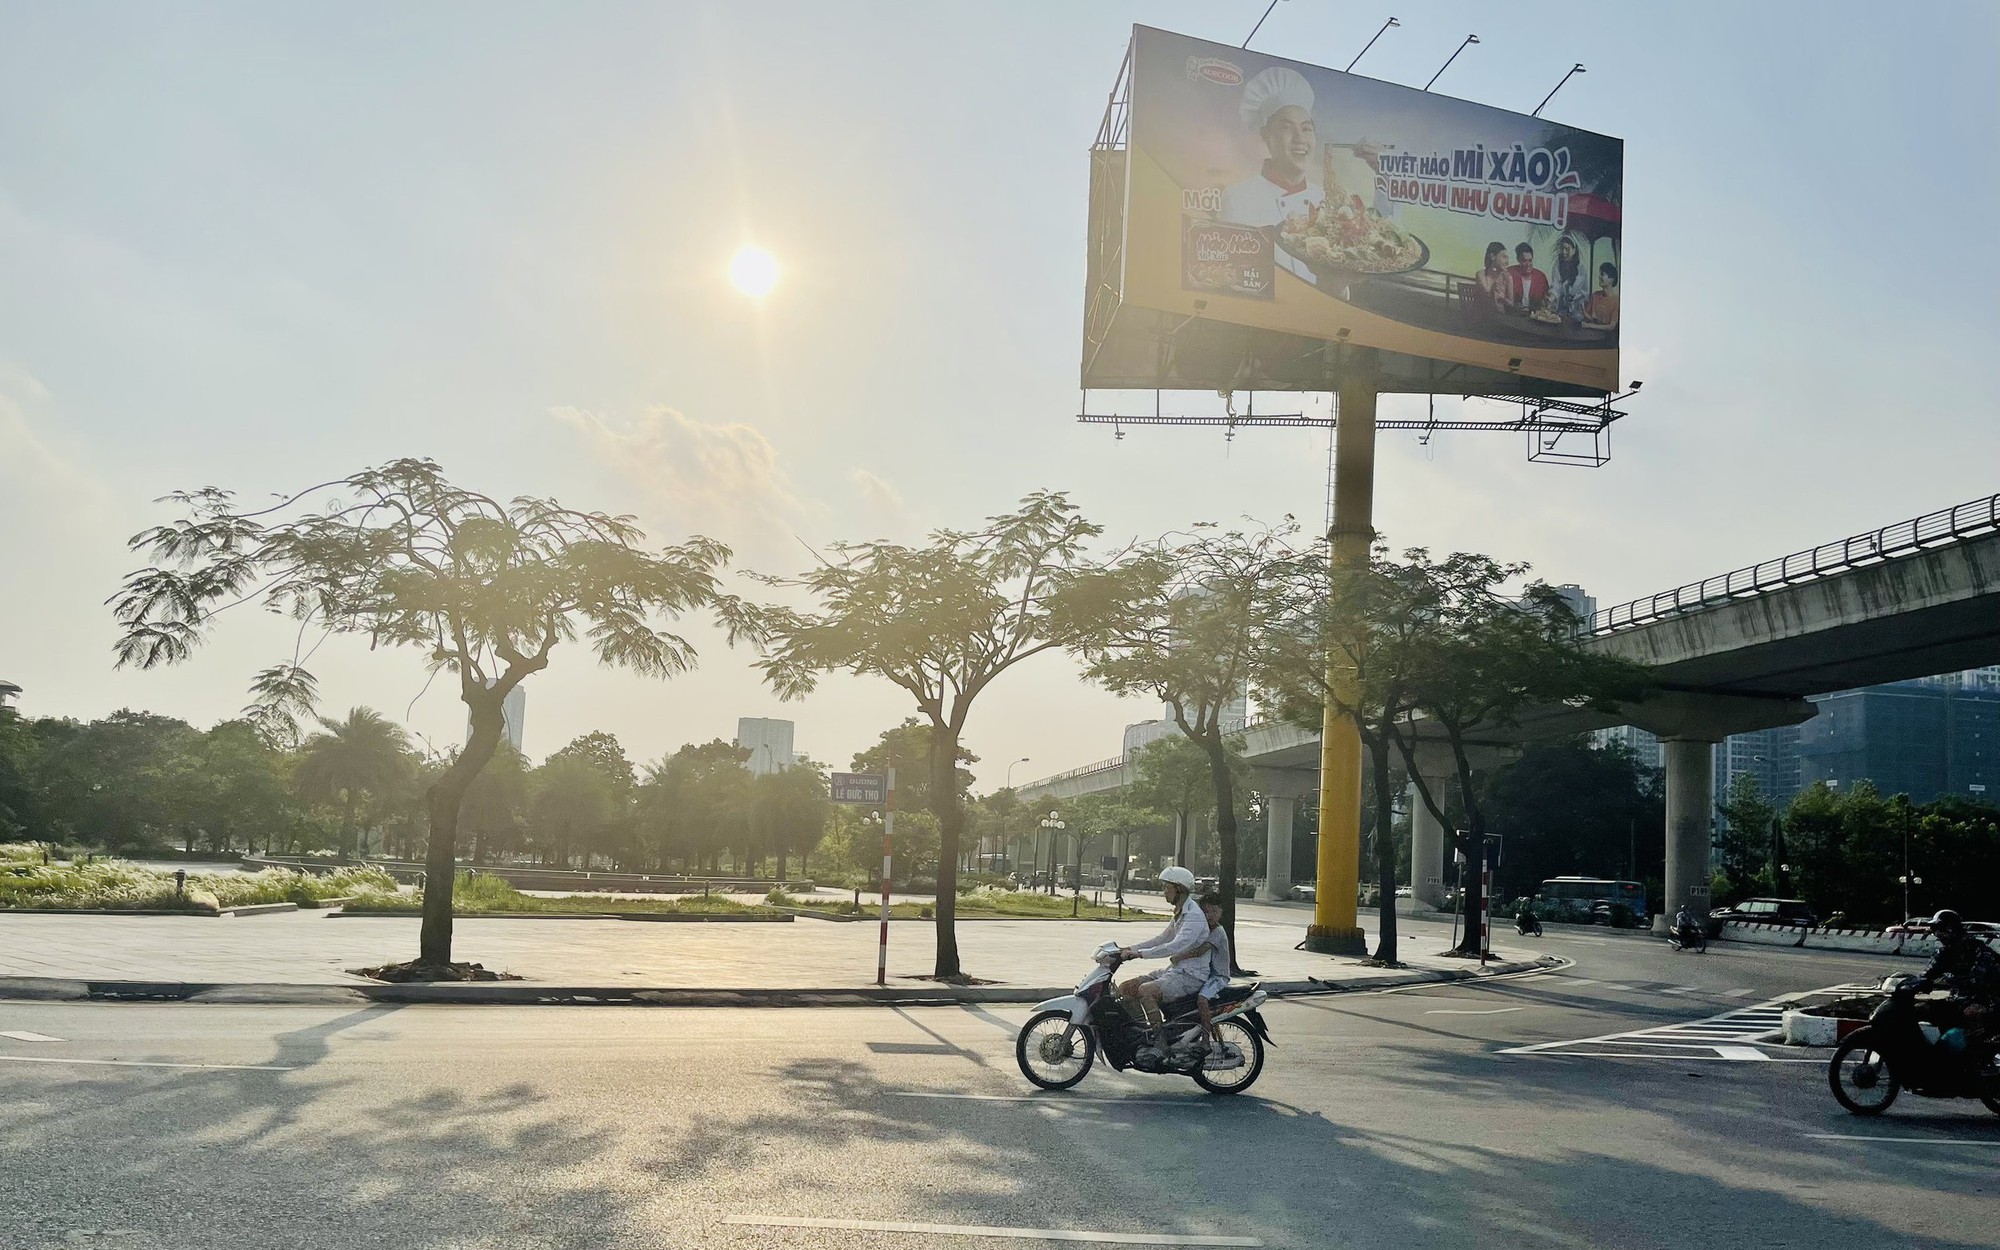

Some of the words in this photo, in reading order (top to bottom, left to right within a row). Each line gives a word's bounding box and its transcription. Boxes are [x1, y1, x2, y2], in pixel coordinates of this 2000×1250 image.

[1379, 152, 1417, 177] TUYỆT
[1419, 152, 1450, 176] HẢO
[1453, 144, 1484, 179] MÌ
[1488, 145, 1550, 186] XÀO
[1183, 188, 1221, 211] Mới
[1421, 182, 1447, 206] VUI
[1451, 186, 1491, 213] NHƯ
